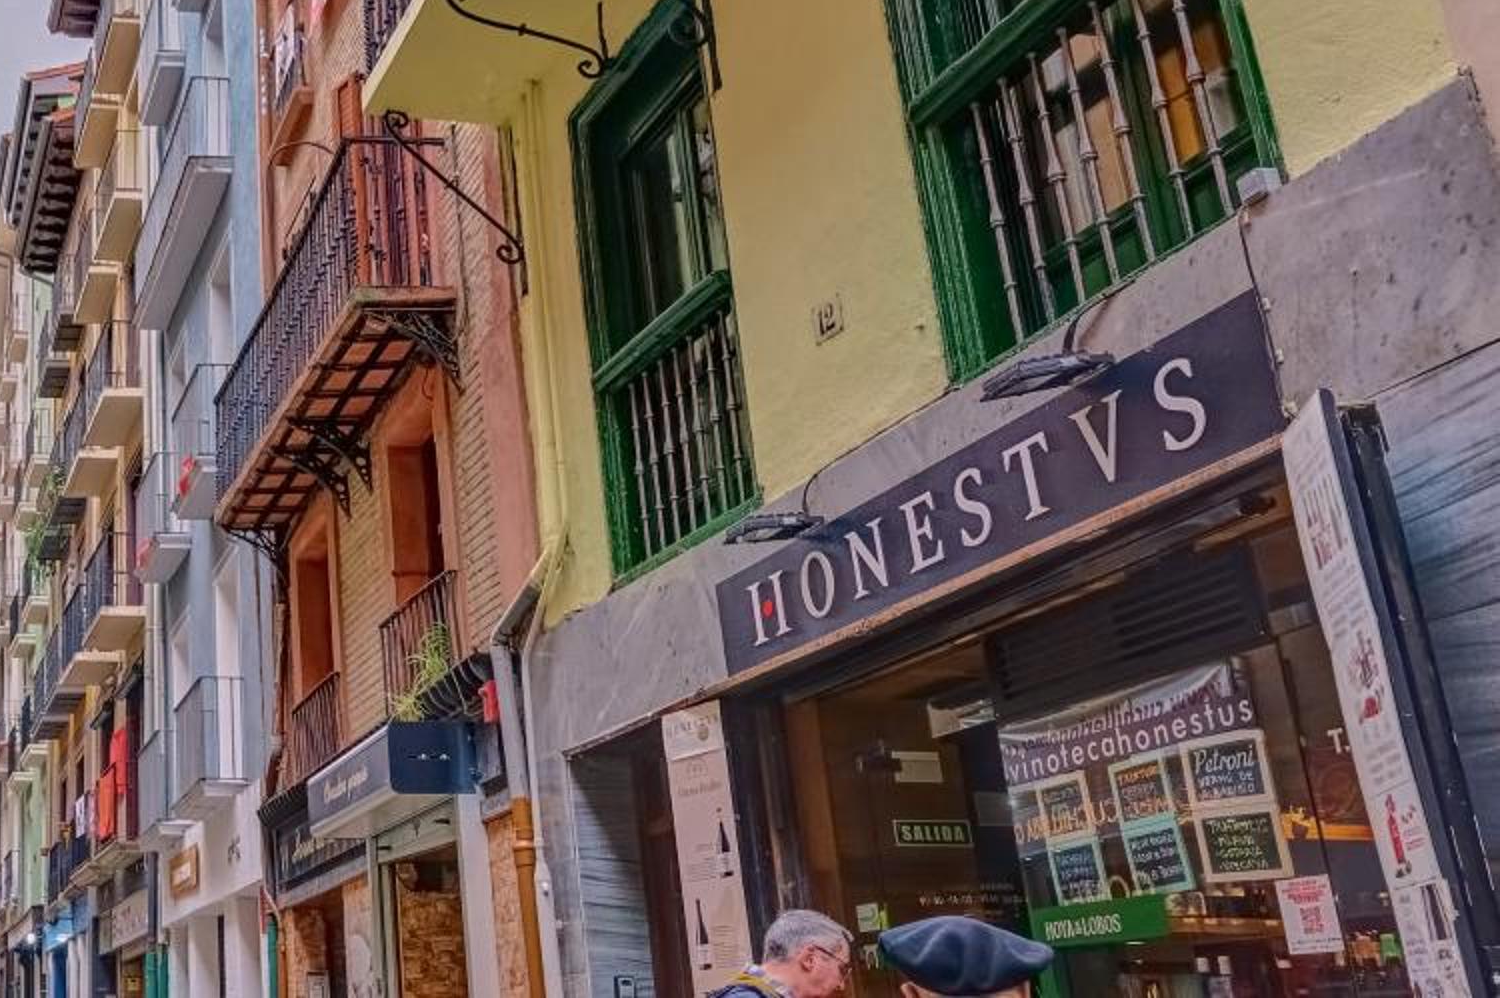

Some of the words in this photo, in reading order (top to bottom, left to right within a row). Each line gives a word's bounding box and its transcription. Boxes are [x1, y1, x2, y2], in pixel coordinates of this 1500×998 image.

[817, 302, 836, 336] 12
[746, 358, 1207, 647] HONESTVS
[1008, 699, 1254, 782] vinotecahonestus
[1194, 745, 1255, 775] Petroni
[901, 825, 965, 842] SALIDA
[1045, 919, 1075, 940] HOYA
[1081, 913, 1122, 936] LOBOS
